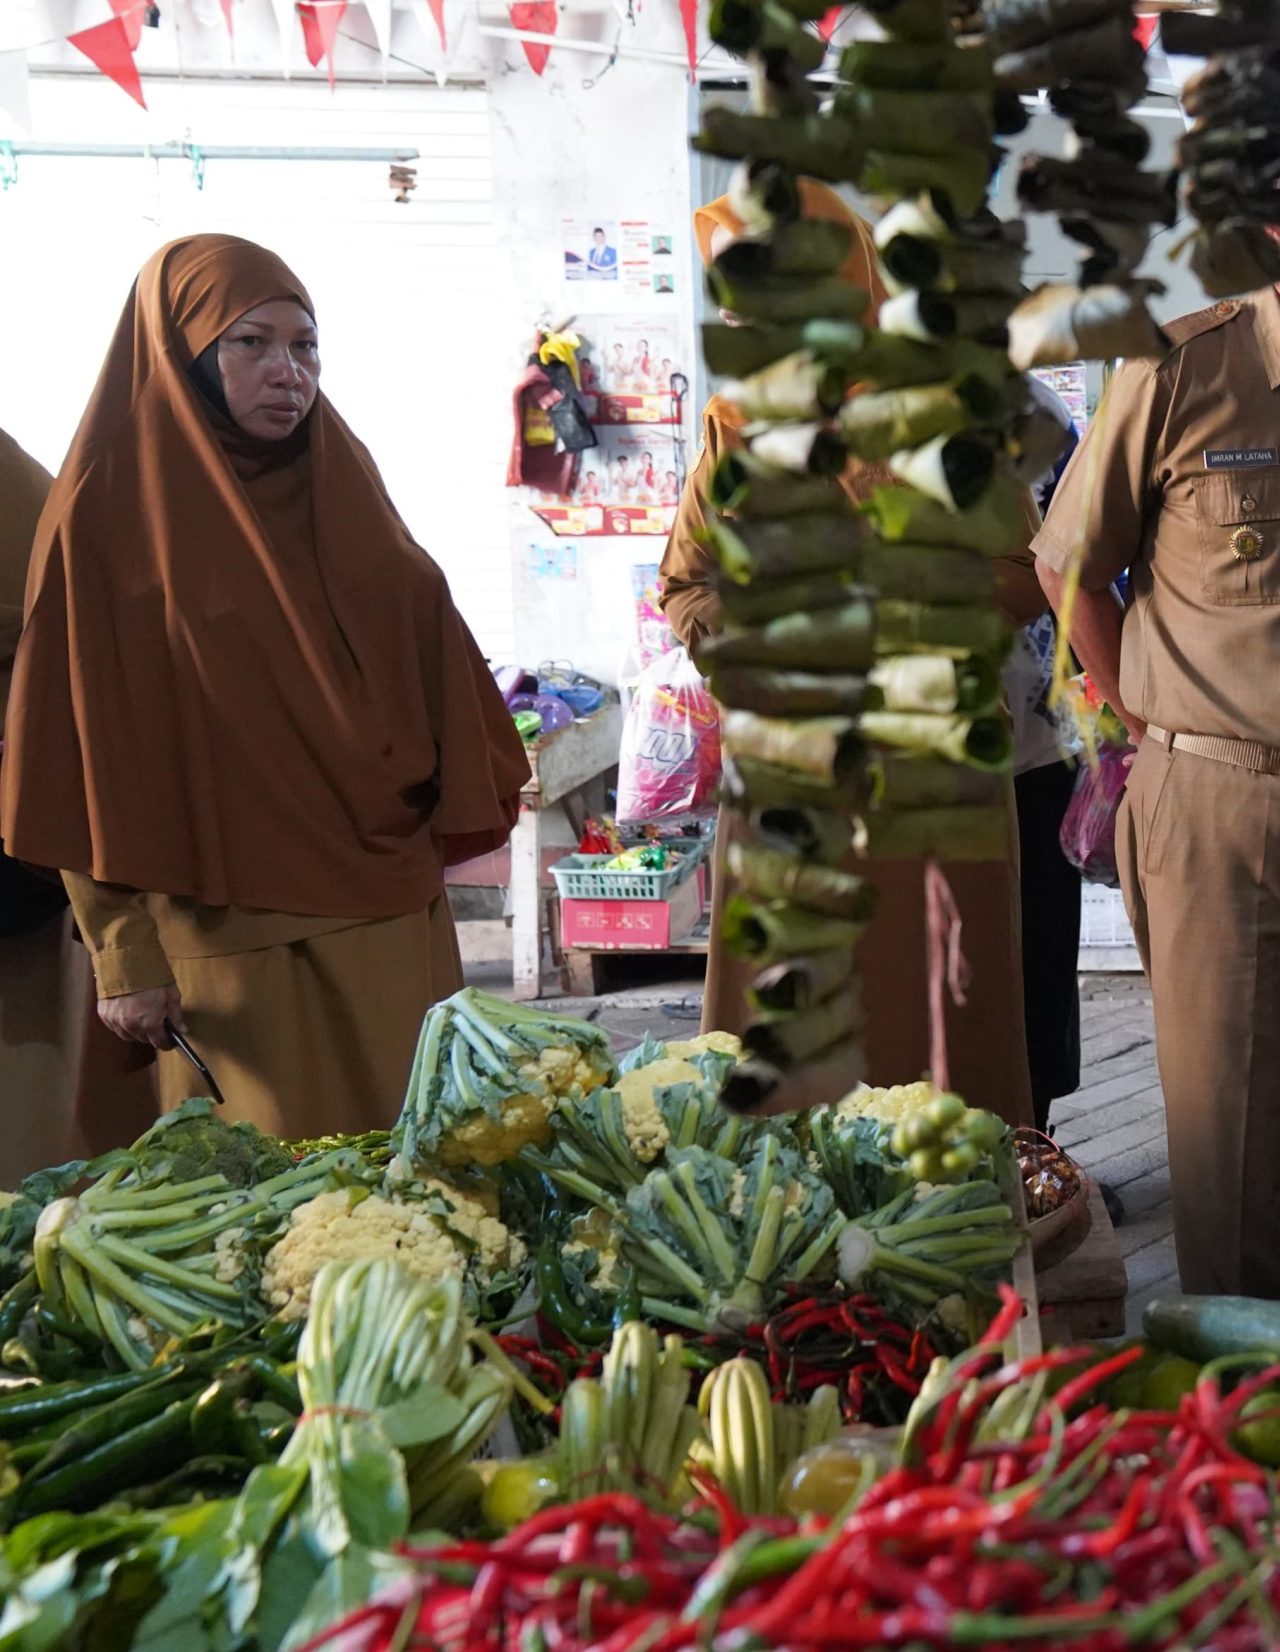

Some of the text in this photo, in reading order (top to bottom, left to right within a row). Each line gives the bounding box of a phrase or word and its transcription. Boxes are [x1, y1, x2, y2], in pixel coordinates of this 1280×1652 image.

[1211, 451, 1272, 463] IMRAN M LATAHA
